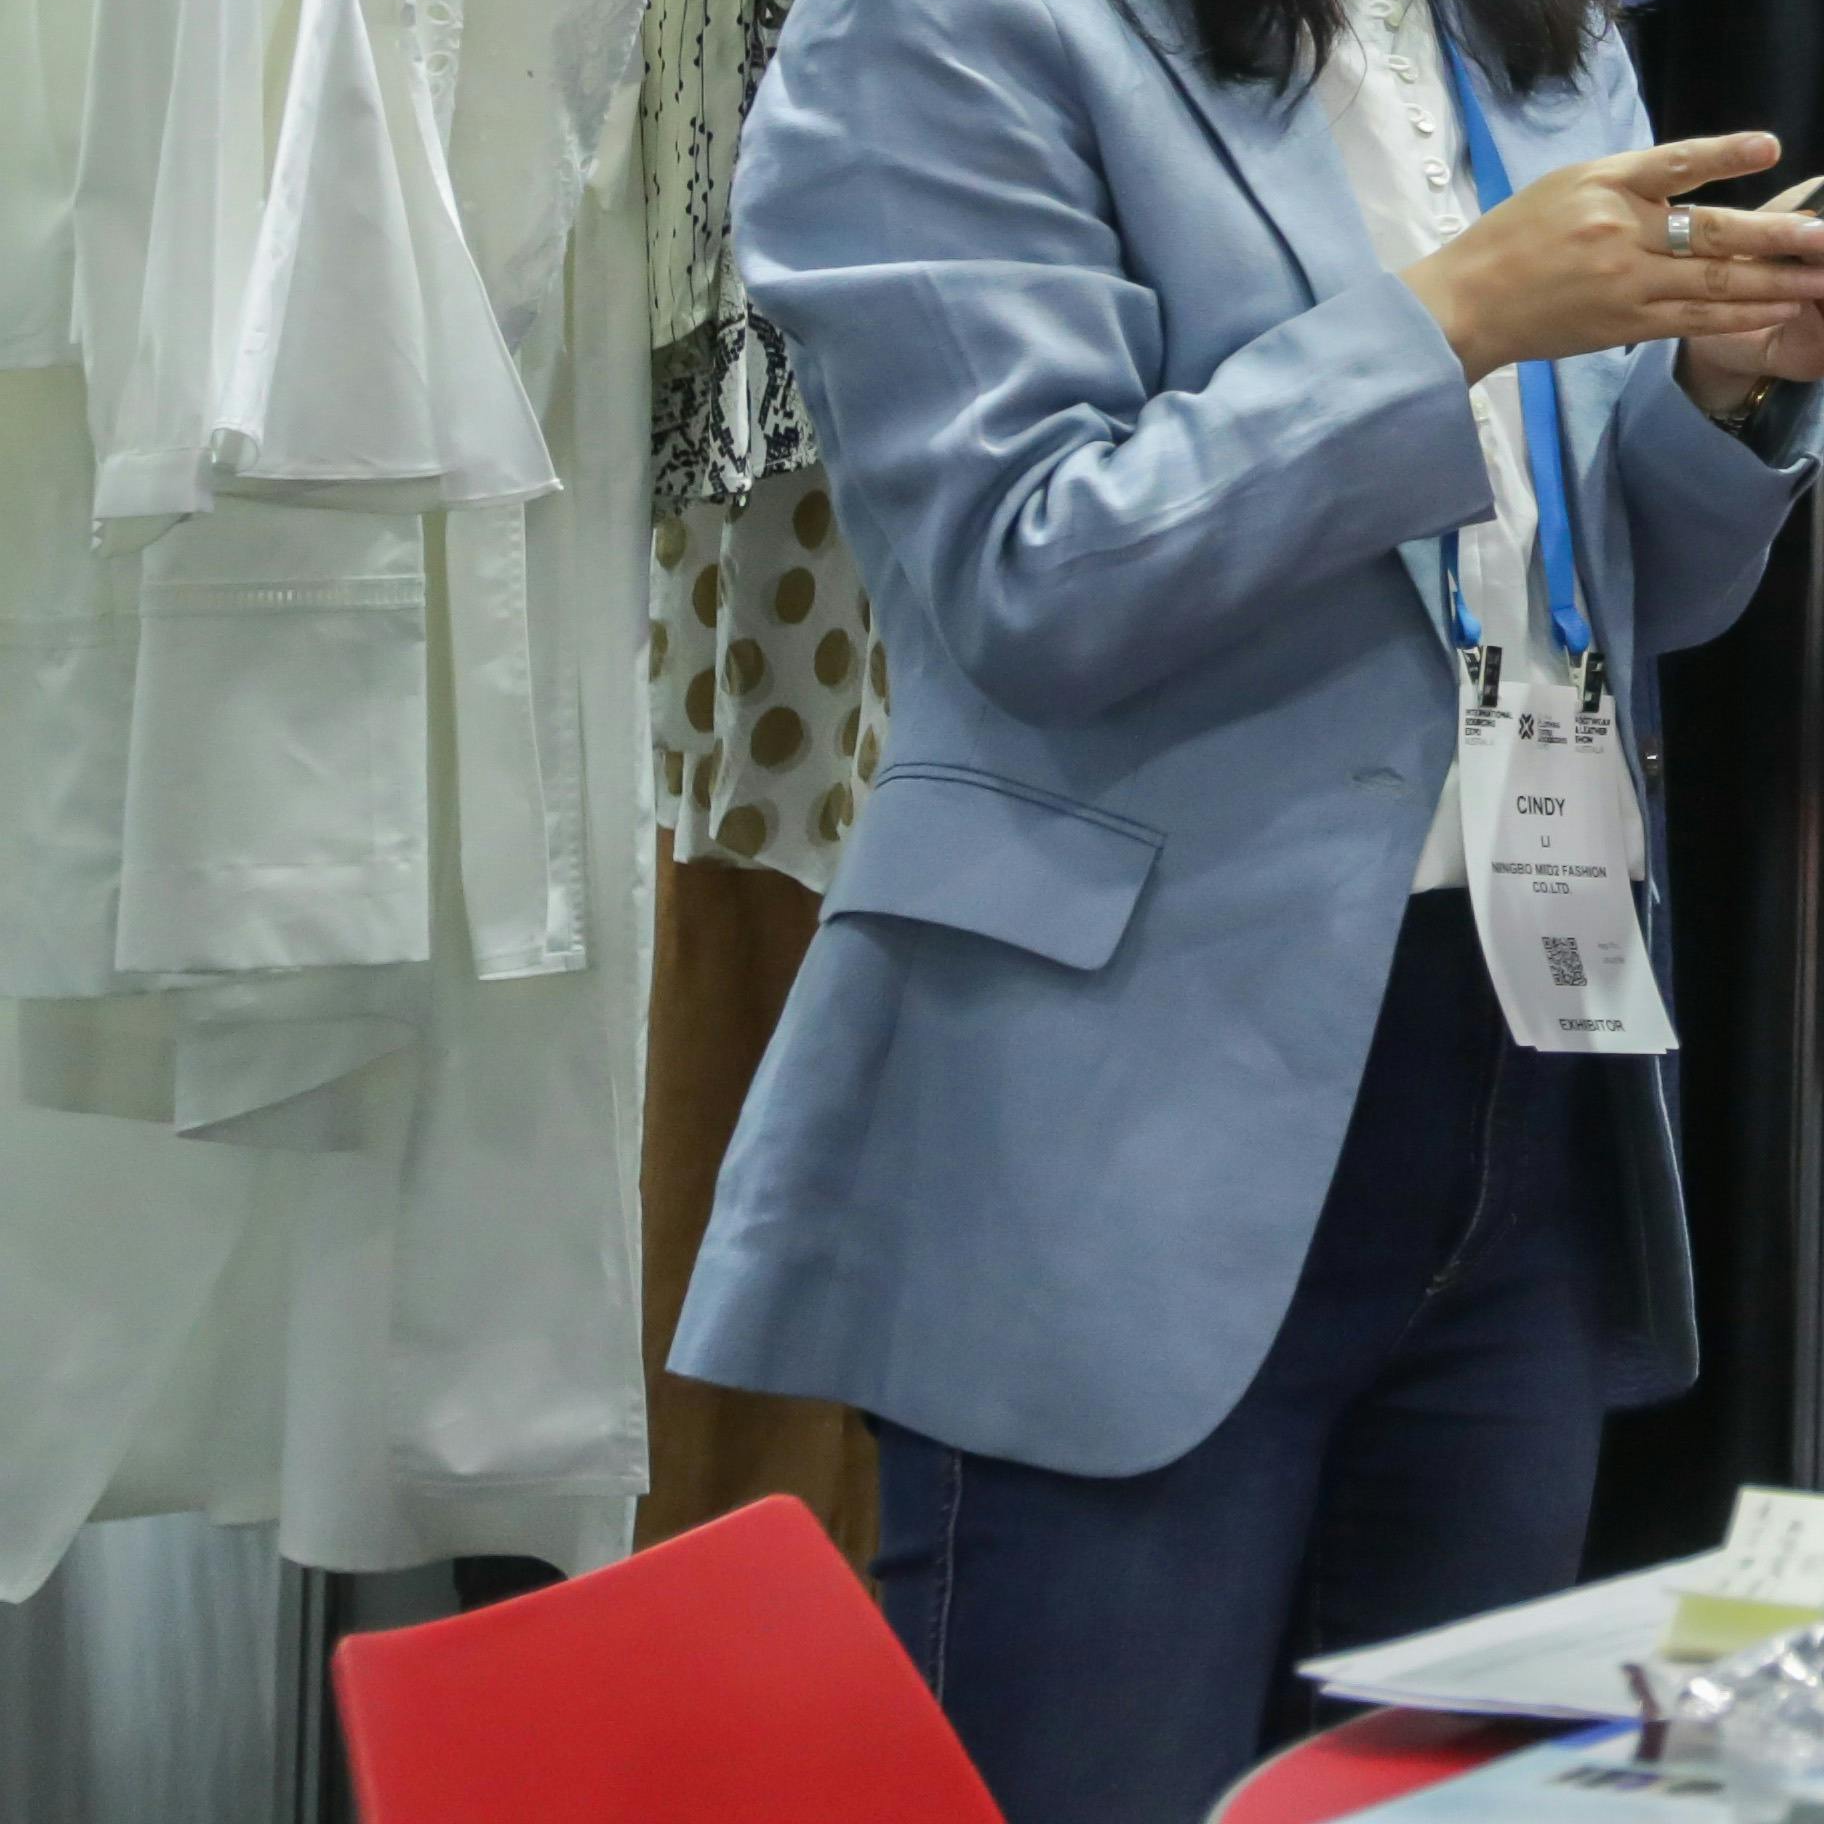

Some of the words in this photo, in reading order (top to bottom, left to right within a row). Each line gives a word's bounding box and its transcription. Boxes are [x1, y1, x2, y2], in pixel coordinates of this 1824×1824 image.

[1516, 795, 1566, 816] CINDY
[1491, 861, 1532, 875] NINGBO
[1562, 865, 1607, 878] FASHION
[1559, 1018, 1626, 1032] EXHIBITOR
